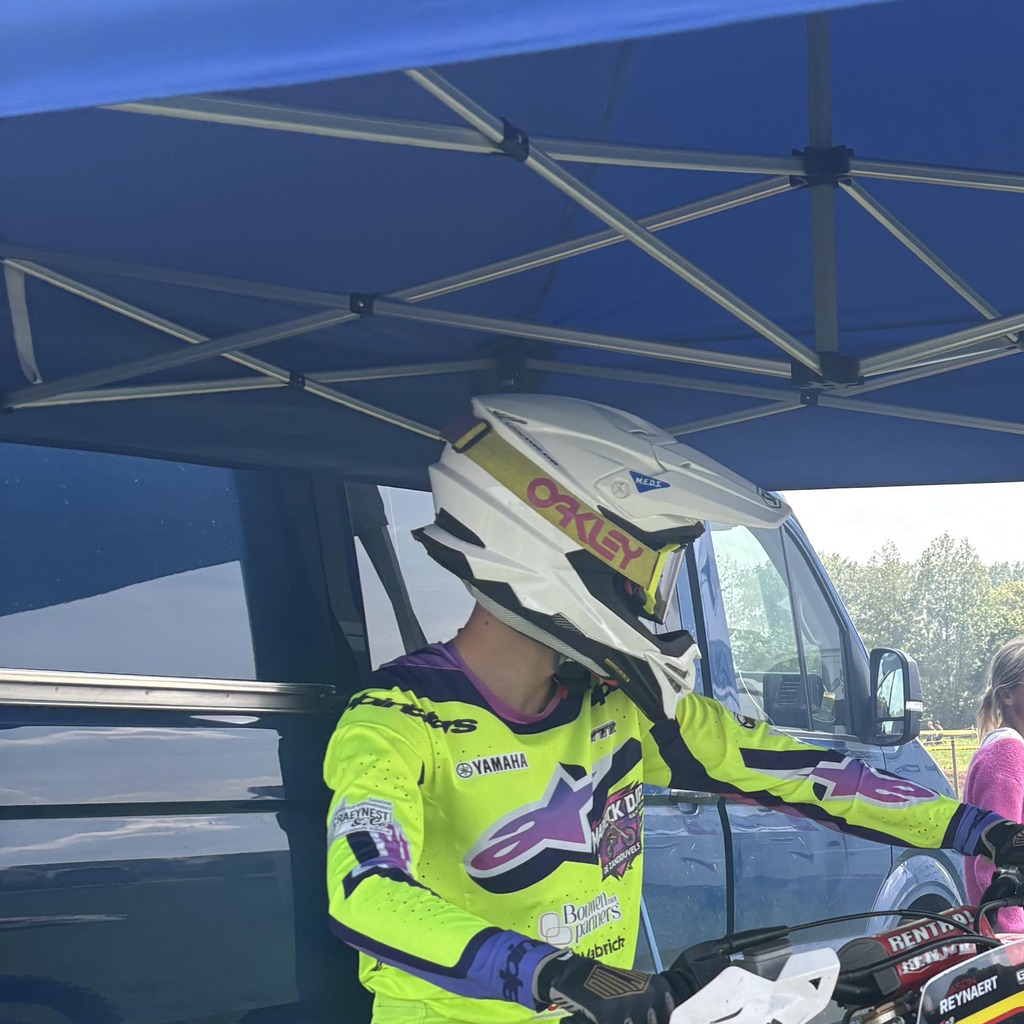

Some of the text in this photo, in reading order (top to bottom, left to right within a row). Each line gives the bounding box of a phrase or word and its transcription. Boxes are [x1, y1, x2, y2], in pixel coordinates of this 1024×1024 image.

[526, 476, 644, 571] OAKLEY
[472, 752, 529, 774] YAMAHA
[938, 975, 999, 1015] REYNAERT
